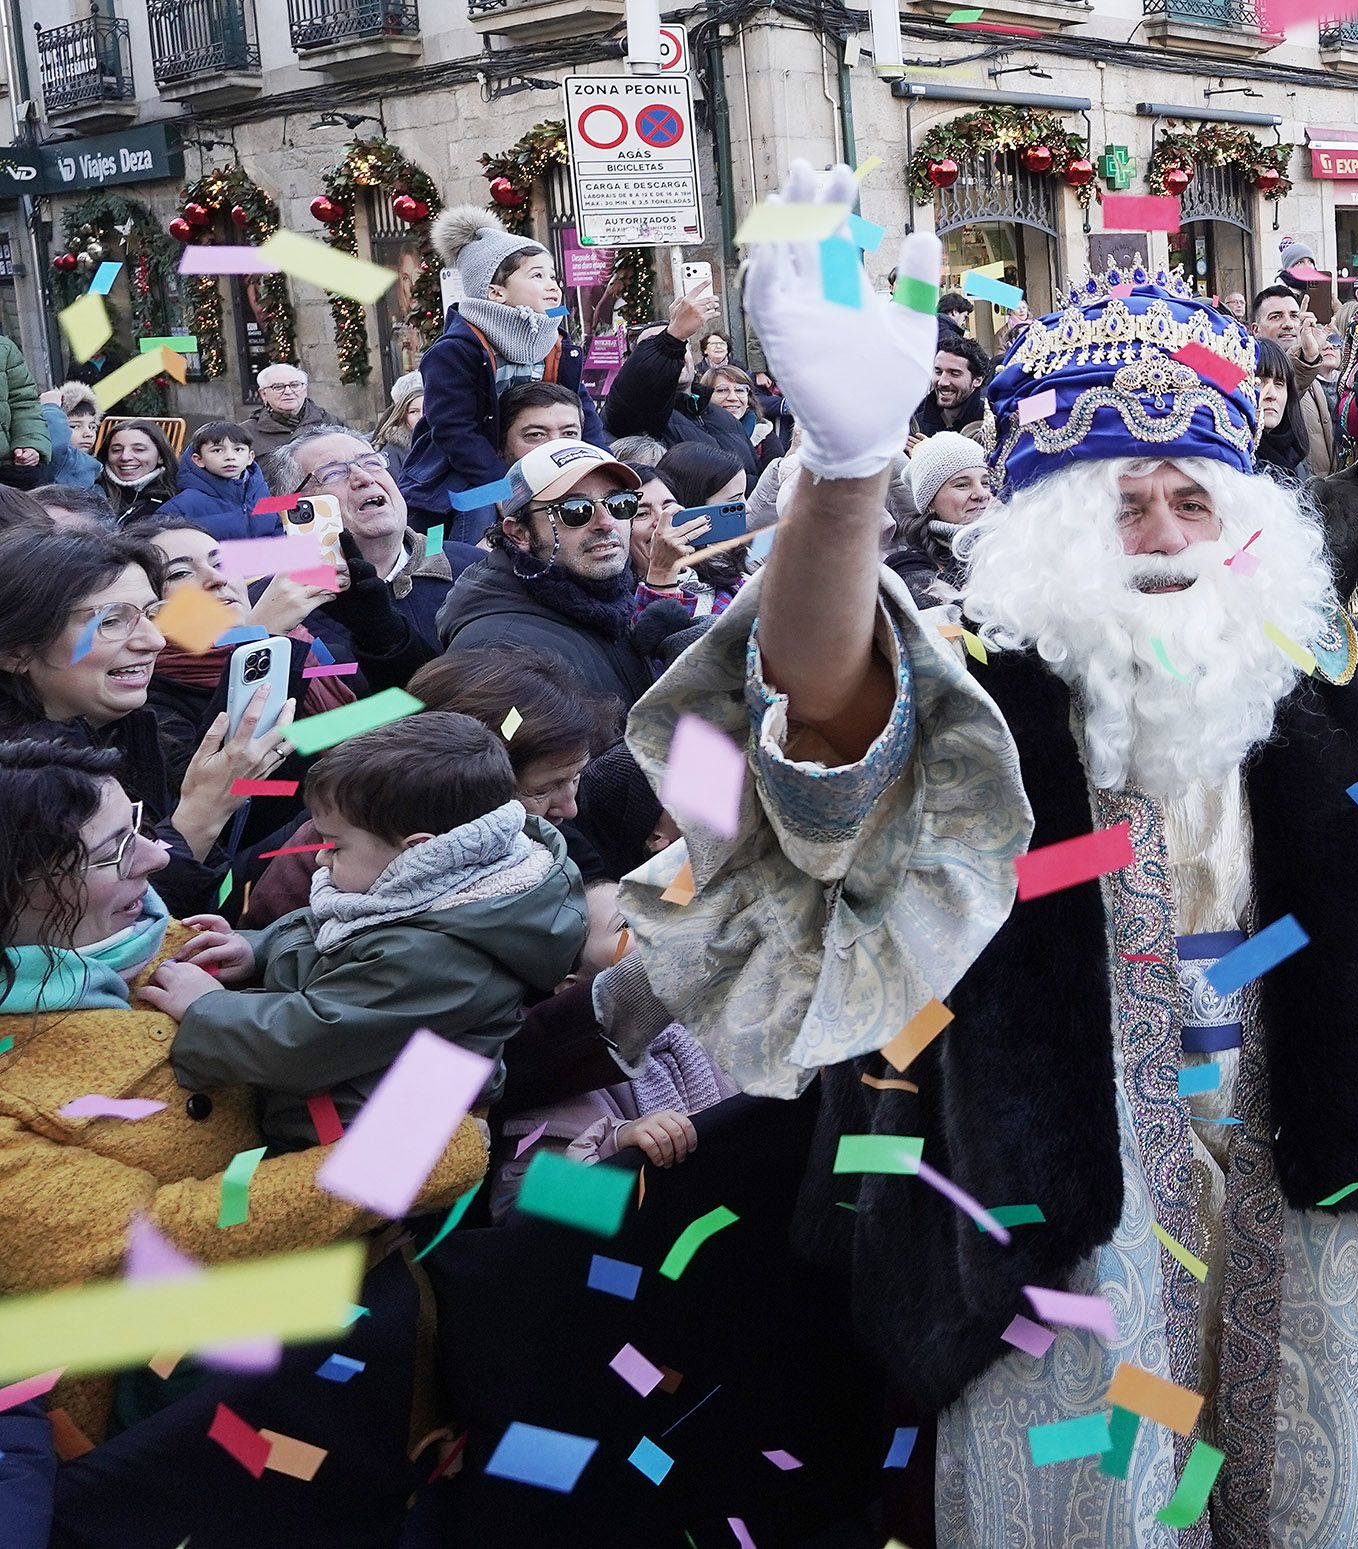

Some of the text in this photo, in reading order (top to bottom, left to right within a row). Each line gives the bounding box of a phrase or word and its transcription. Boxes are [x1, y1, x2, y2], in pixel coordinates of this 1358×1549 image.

[574, 84, 681, 95] ZONA PEONIL
[618, 148, 652, 159] AGÁS
[79, 152, 117, 182] Viajes
[119, 148, 153, 173] Deza
[607, 163, 664, 172] BICICLETAS
[634, 181, 688, 189] DESCARGA
[605, 216, 677, 225] AUTORIZADOS
